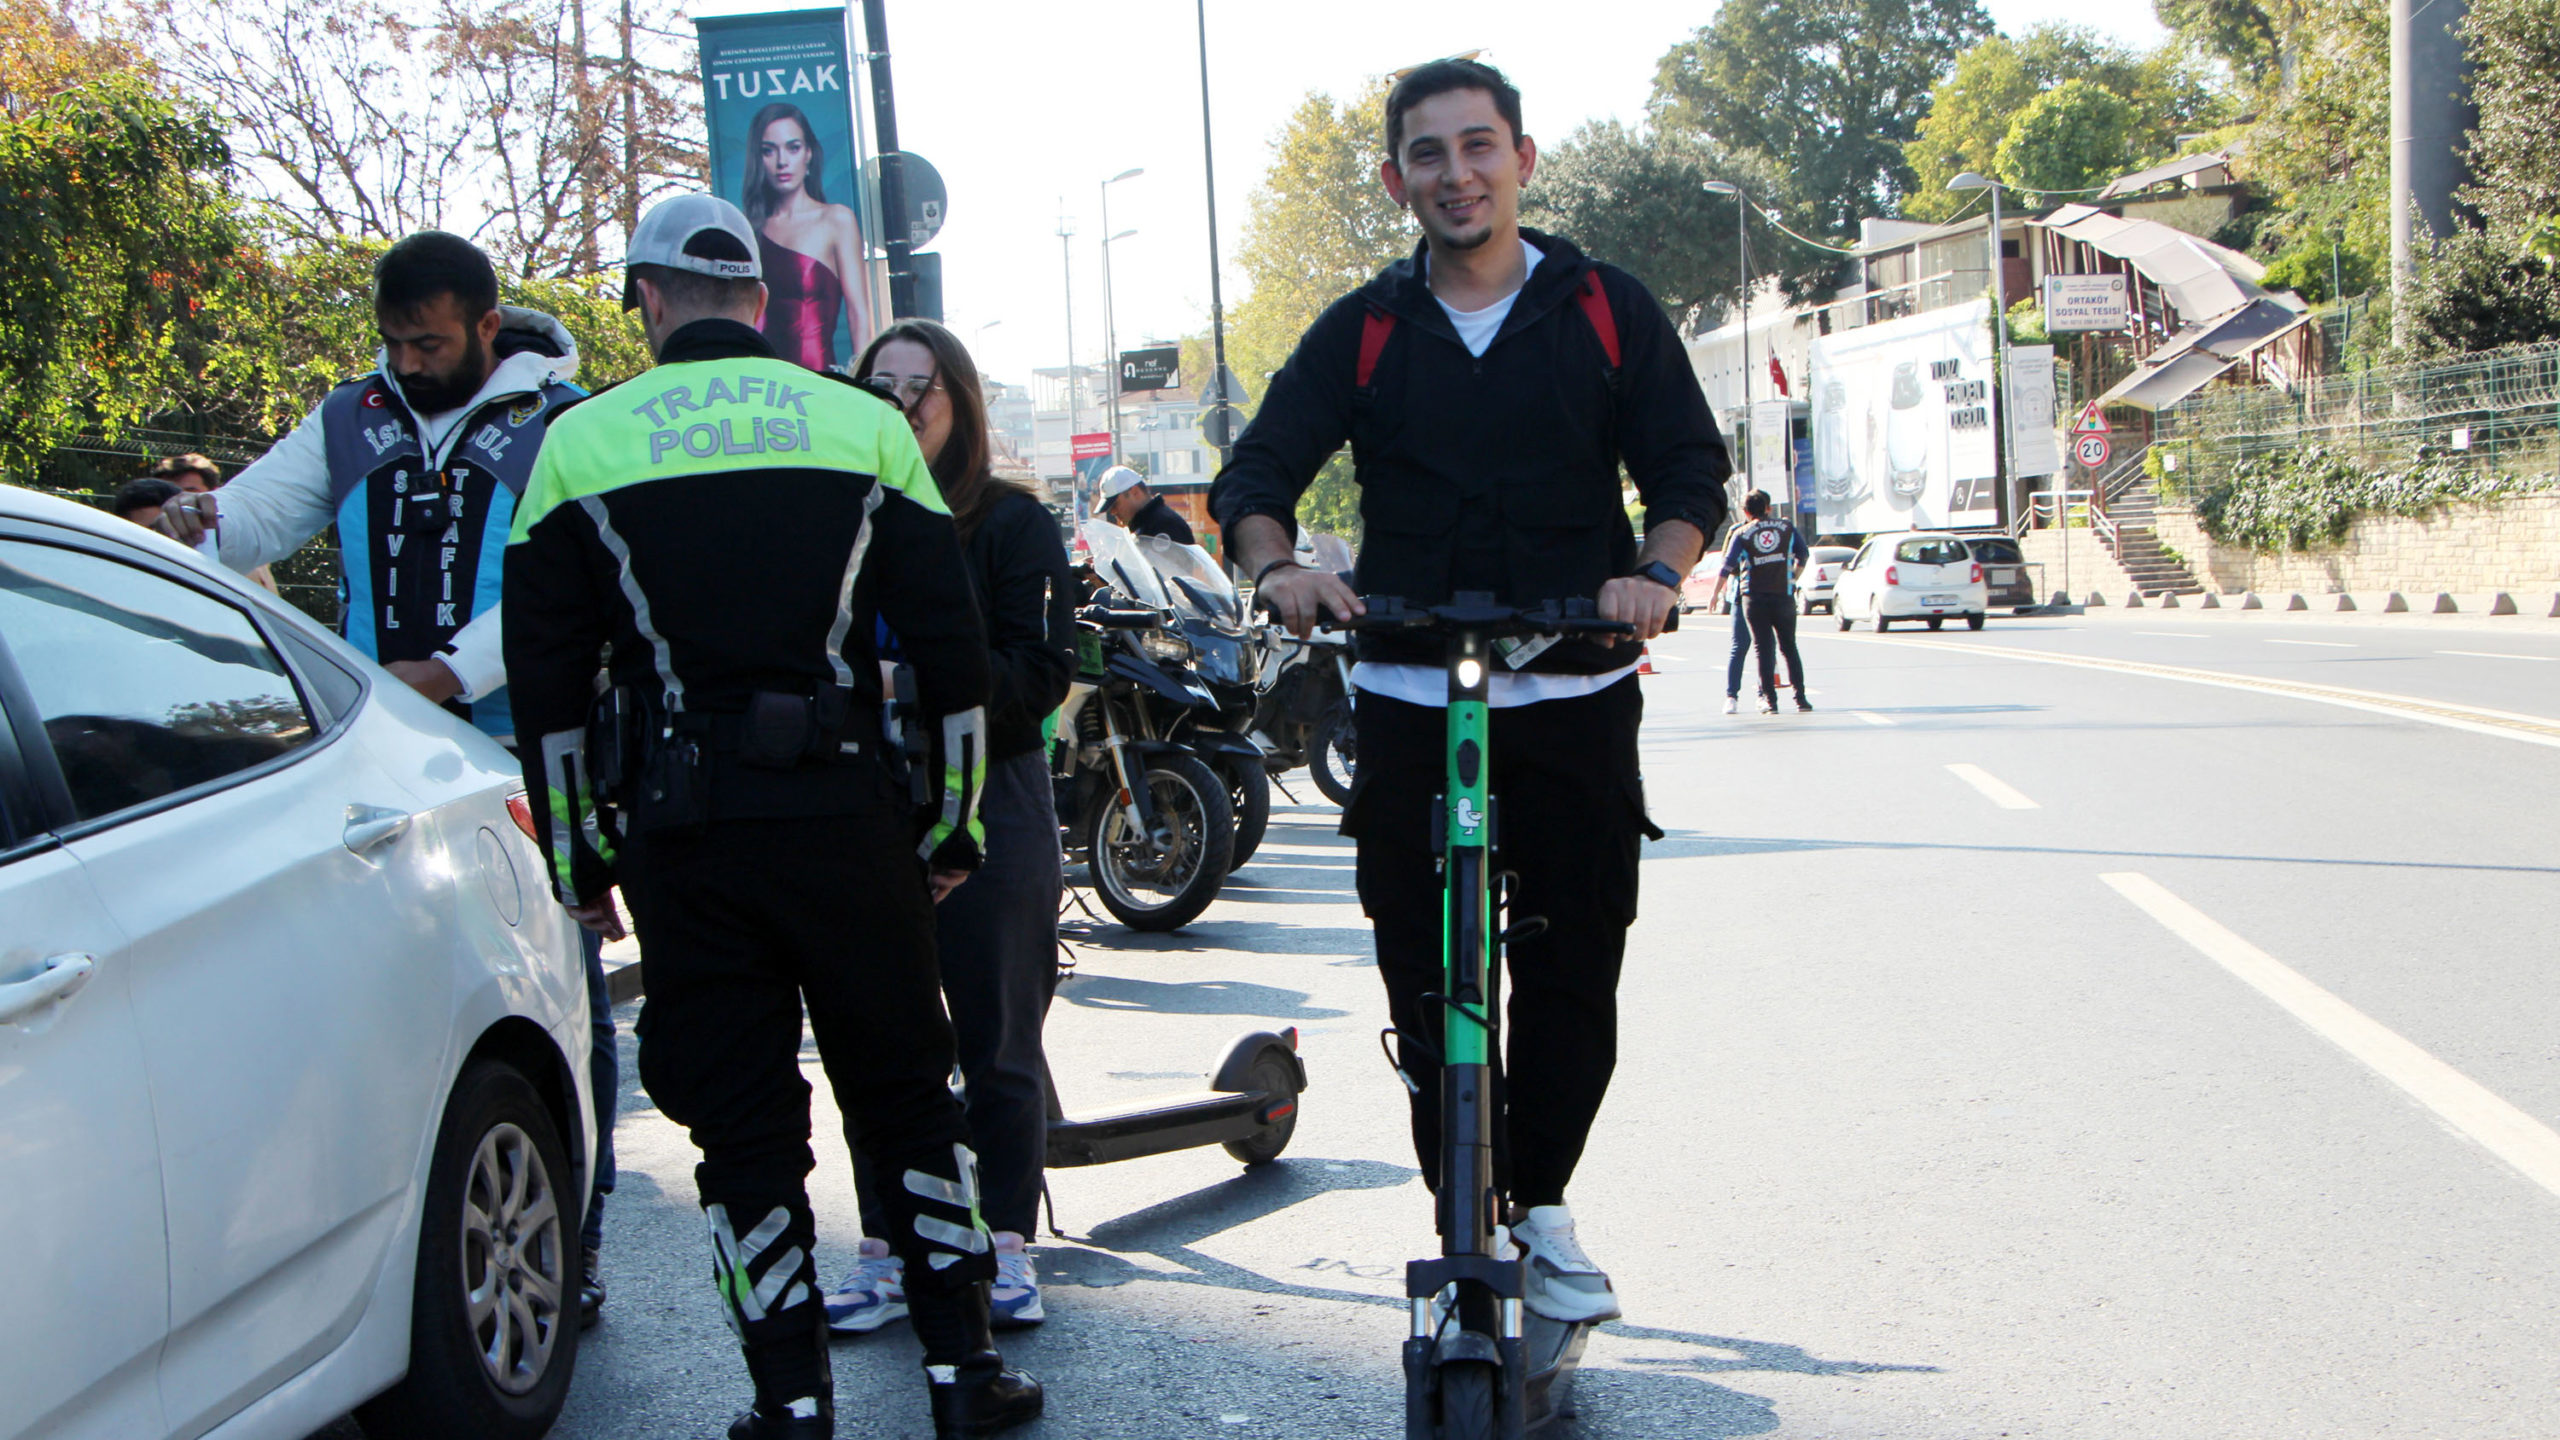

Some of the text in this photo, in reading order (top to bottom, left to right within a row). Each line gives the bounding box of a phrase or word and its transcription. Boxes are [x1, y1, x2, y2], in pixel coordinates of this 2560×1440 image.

[712, 64, 840, 100] TUZAK
[2055, 308, 2089, 316] SOSYAL
[2067, 295, 2109, 305] ORTAKÖY
[631, 375, 815, 429] TRAFİK
[649, 416, 812, 465] POLİSİ
[2082, 442, 2103, 458] 20
[436, 468, 470, 626] TRAFİK
